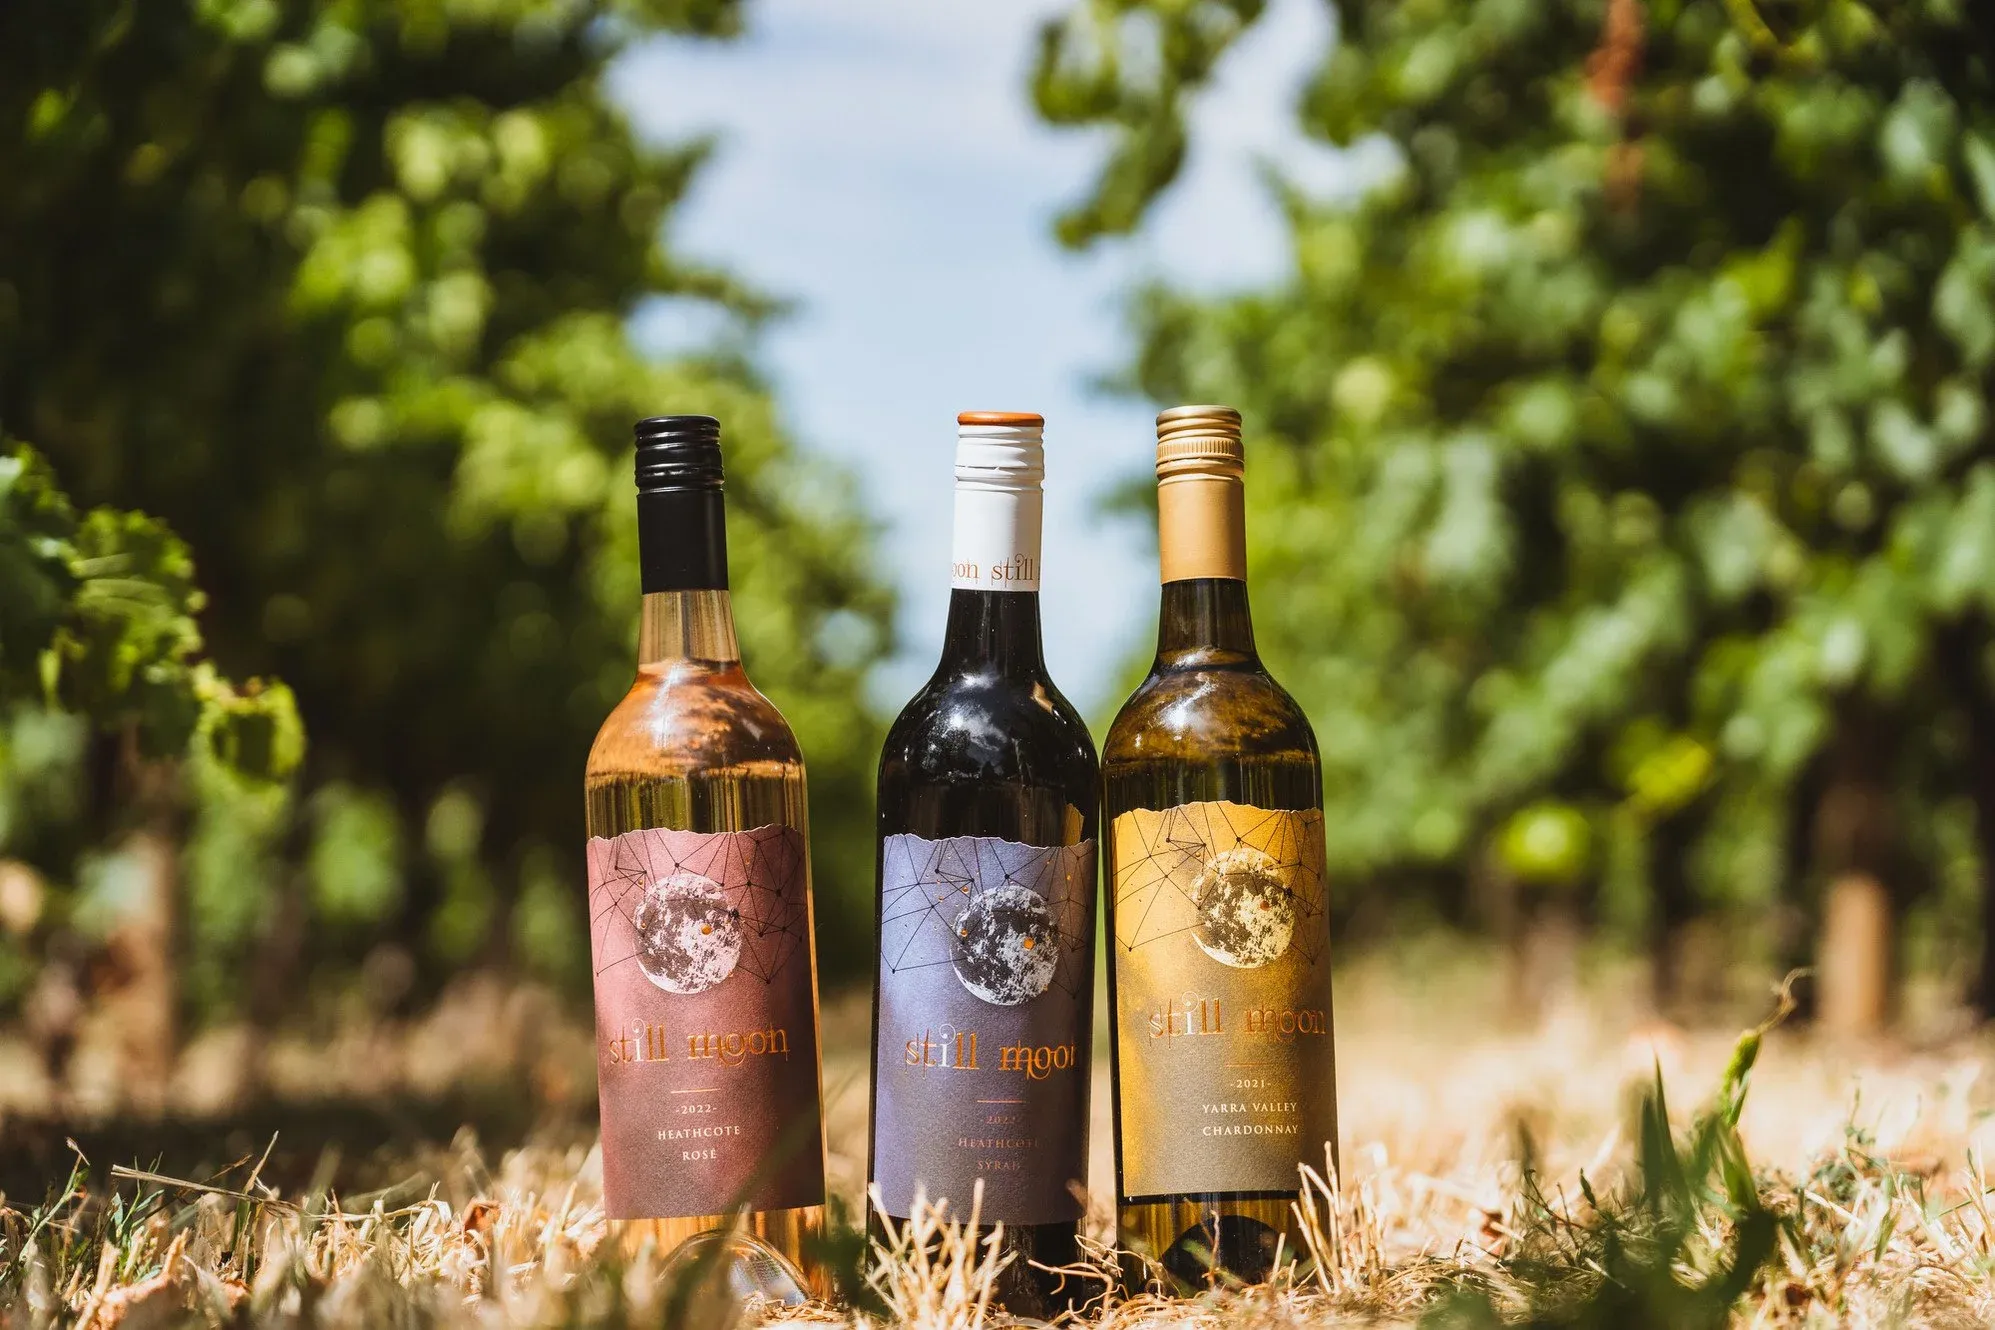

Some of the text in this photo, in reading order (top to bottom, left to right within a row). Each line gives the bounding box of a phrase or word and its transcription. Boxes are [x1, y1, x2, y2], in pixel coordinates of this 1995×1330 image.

[991, 553, 1034, 587] still
[1148, 991, 1326, 1048] still moon
[606, 1018, 790, 1068] still moon
[904, 1023, 980, 1079] still
[1202, 1102, 1298, 1114] YARRA VALLEY
[658, 1125, 741, 1141] HEATHCOTE
[1202, 1124, 1299, 1137] CHARDONNAY
